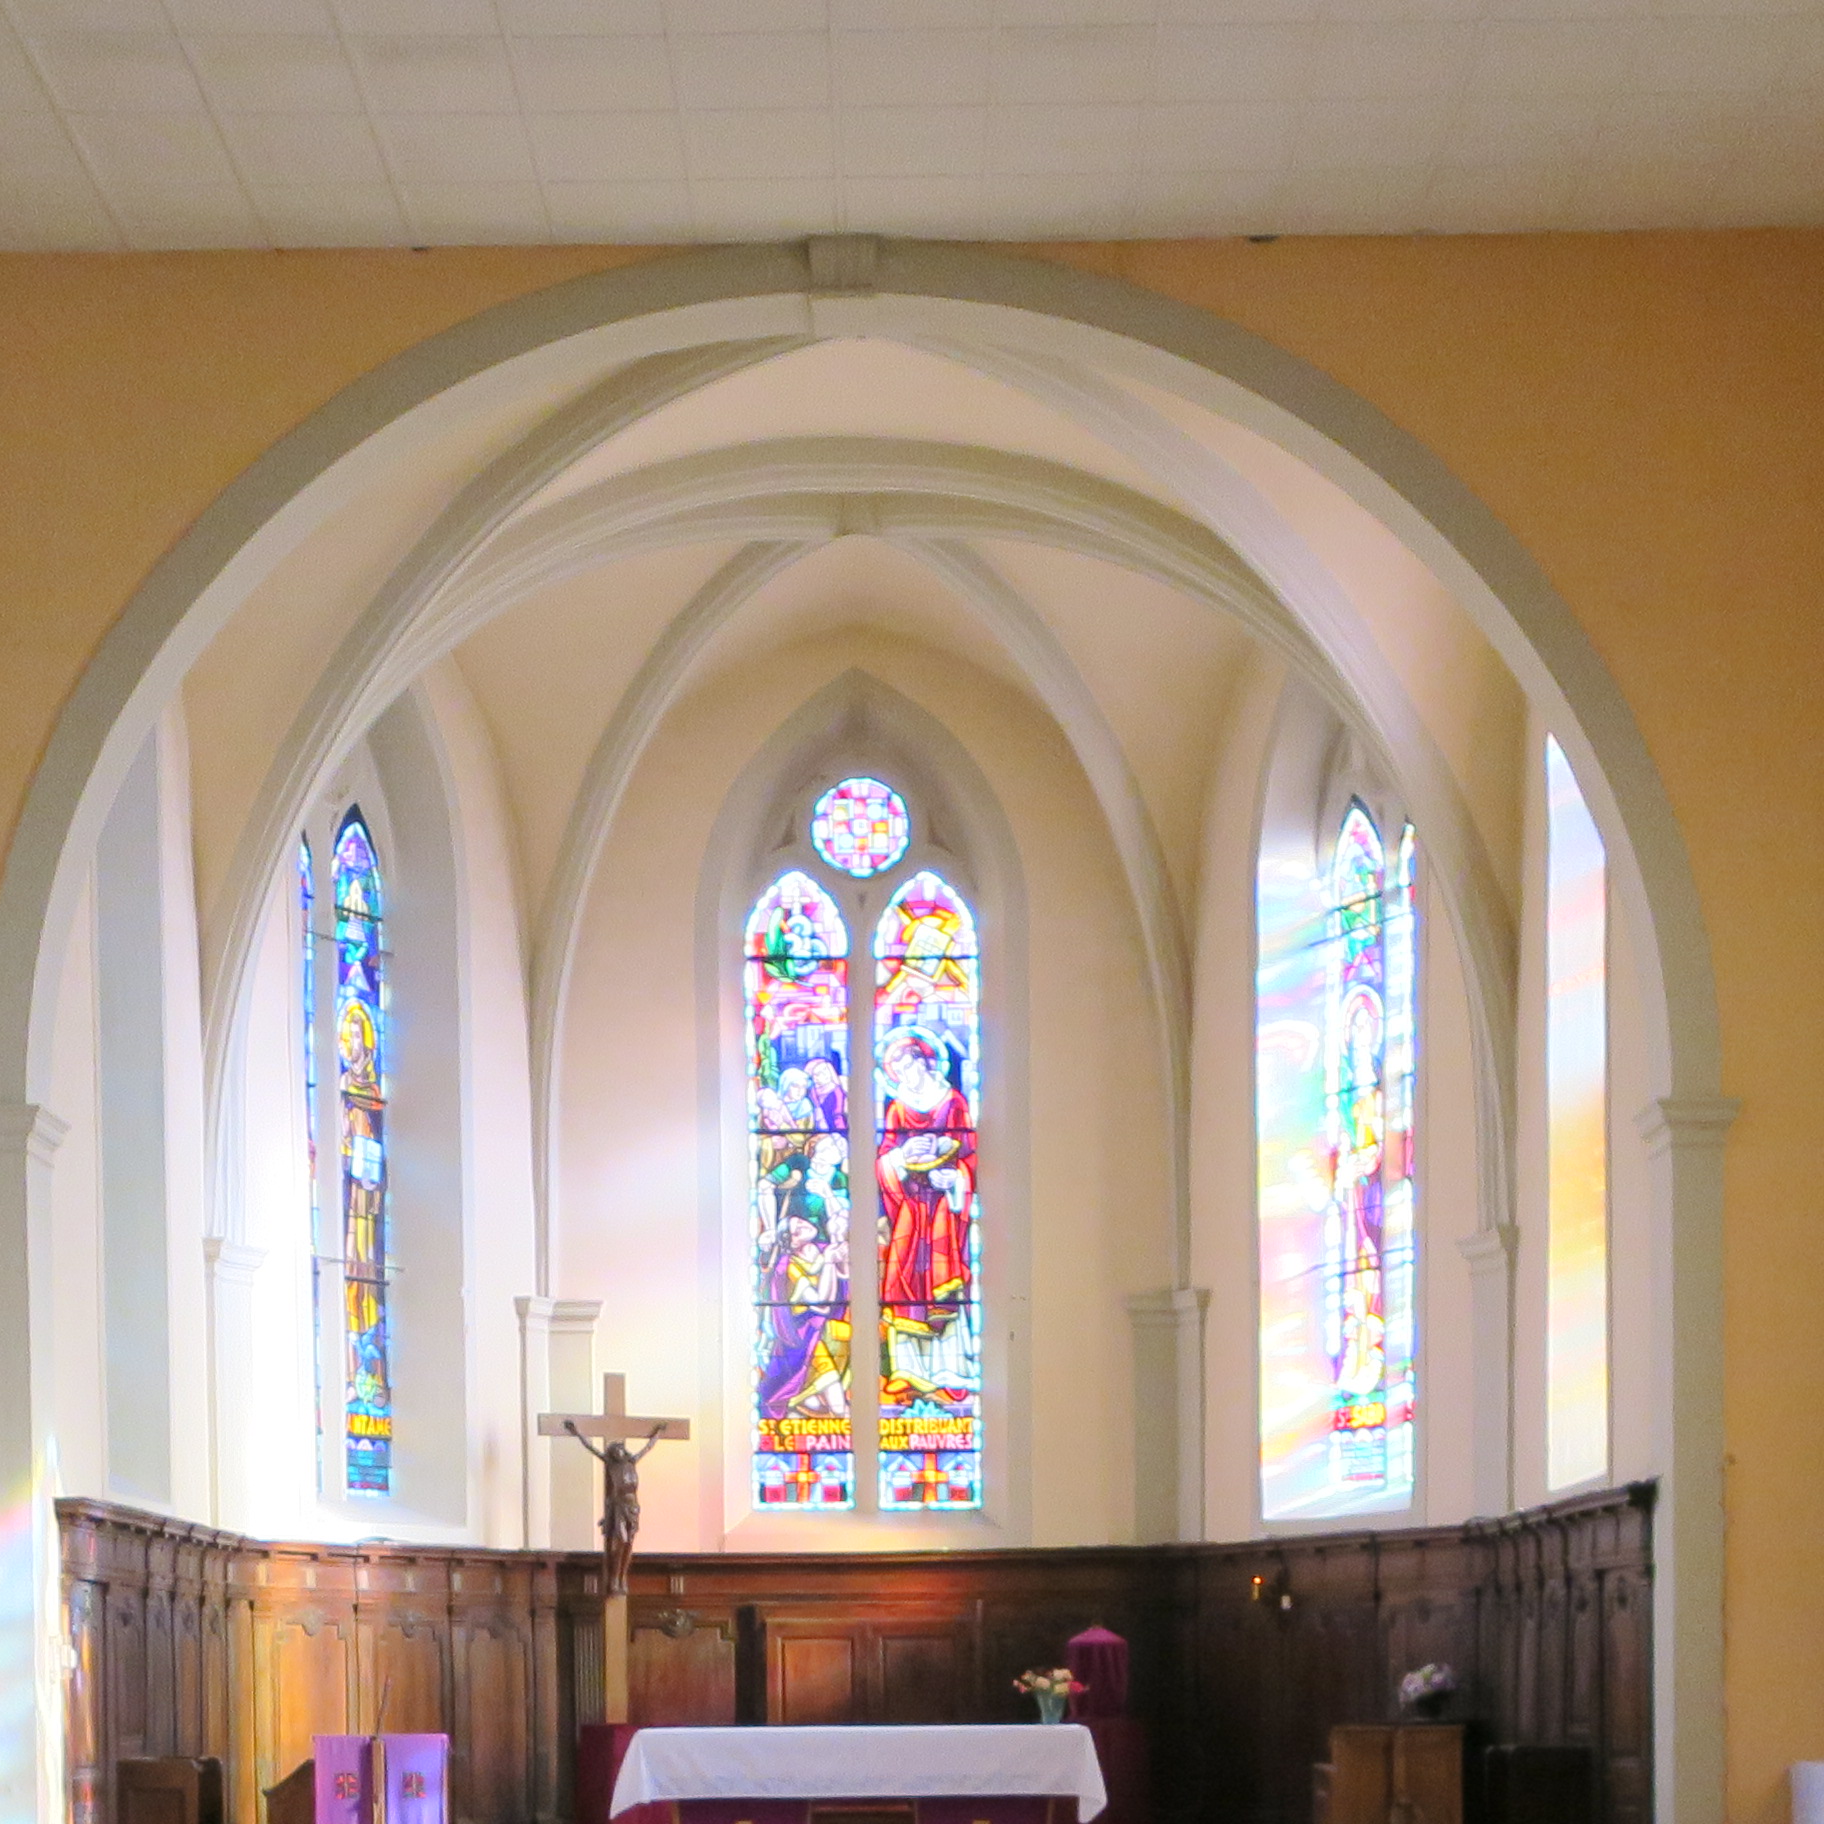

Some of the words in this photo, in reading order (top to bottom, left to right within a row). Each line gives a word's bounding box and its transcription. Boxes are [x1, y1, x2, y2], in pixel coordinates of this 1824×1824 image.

[879, 1417, 973, 1435] DISTRIBUANT
[774, 1435, 794, 1451] LE
[806, 1434, 851, 1451] PAIN
[880, 1435, 908, 1450] AUX
[909, 1433, 973, 1450] PAUVRES
